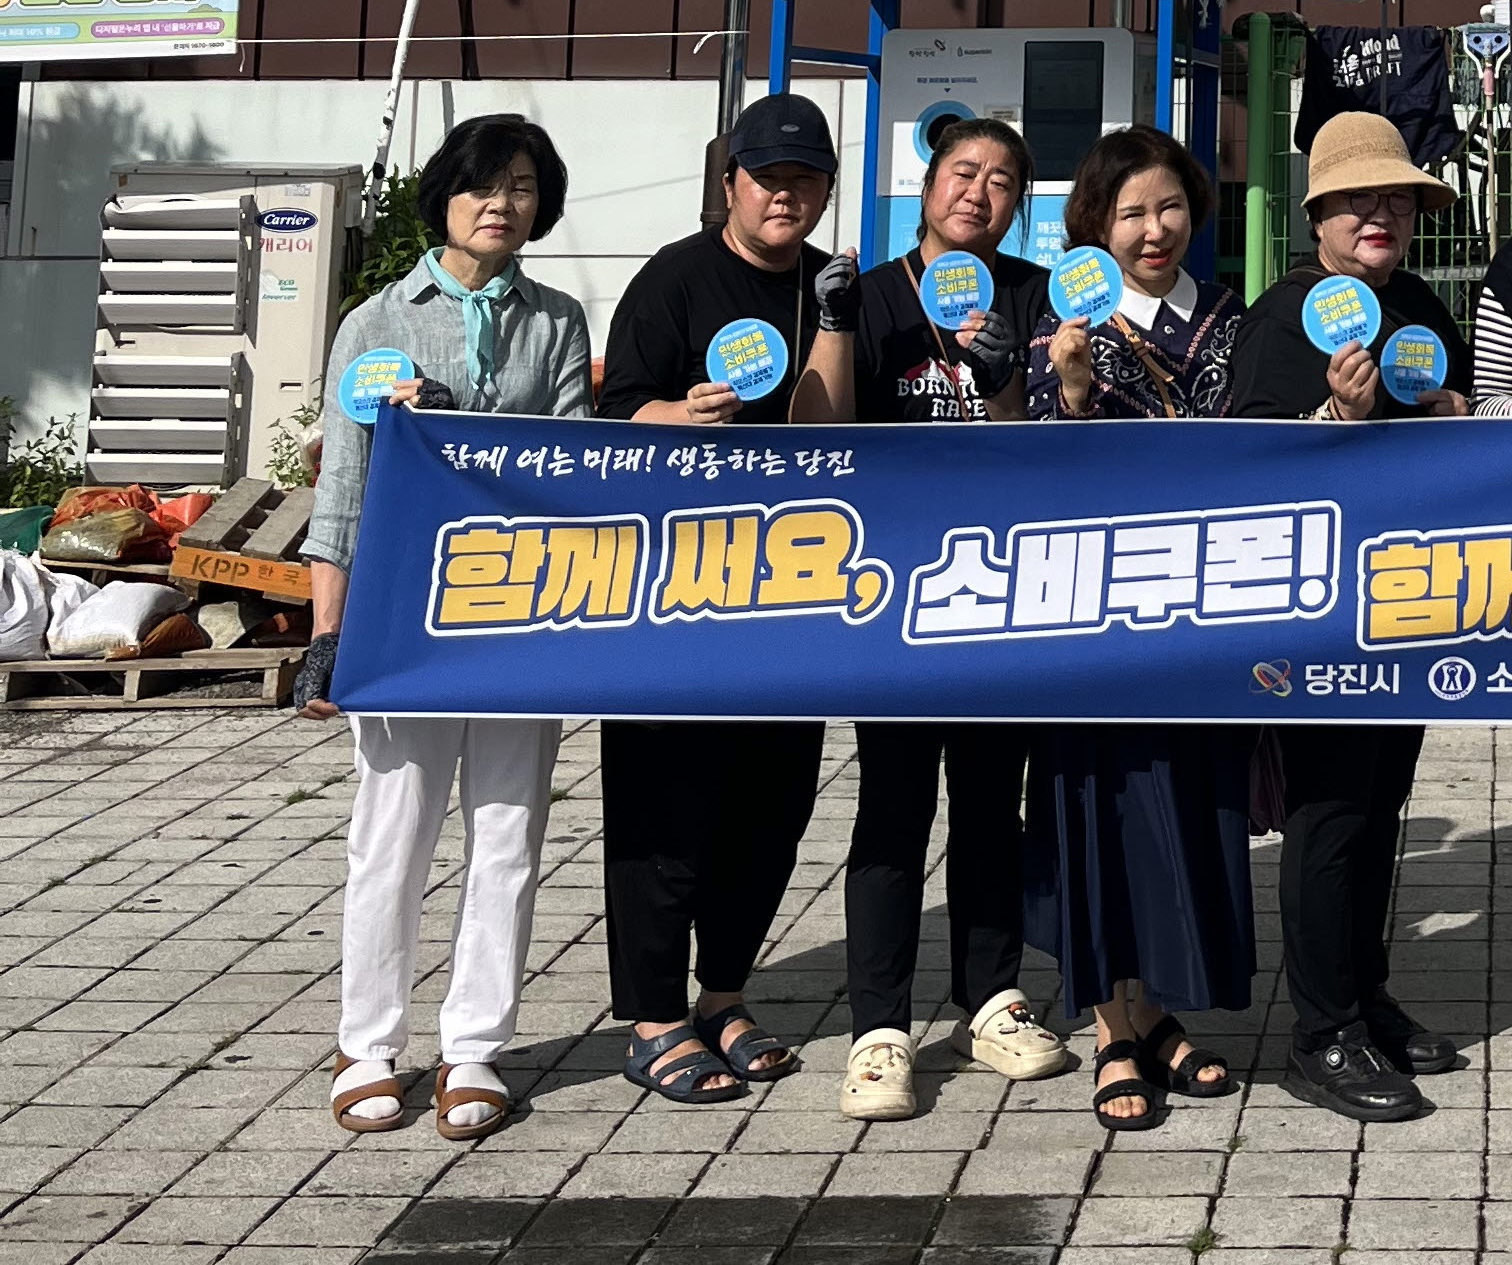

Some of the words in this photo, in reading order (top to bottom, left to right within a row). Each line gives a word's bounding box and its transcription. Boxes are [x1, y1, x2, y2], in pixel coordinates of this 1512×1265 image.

[263, 212, 311, 226] Carrier
[259, 237, 313, 253] 캐리어
[441, 442, 509, 478] 함께
[516, 445, 576, 478] 여는
[583, 444, 656, 480] 미래!
[666, 441, 786, 480] 생동하는
[795, 448, 857, 477] 당진
[191, 554, 249, 582] KPP
[427, 515, 648, 635] 함께
[649, 498, 893, 625] 써요,
[902, 500, 1342, 645] 소비쿠폰!
[1304, 662, 1401, 697] 당진시
